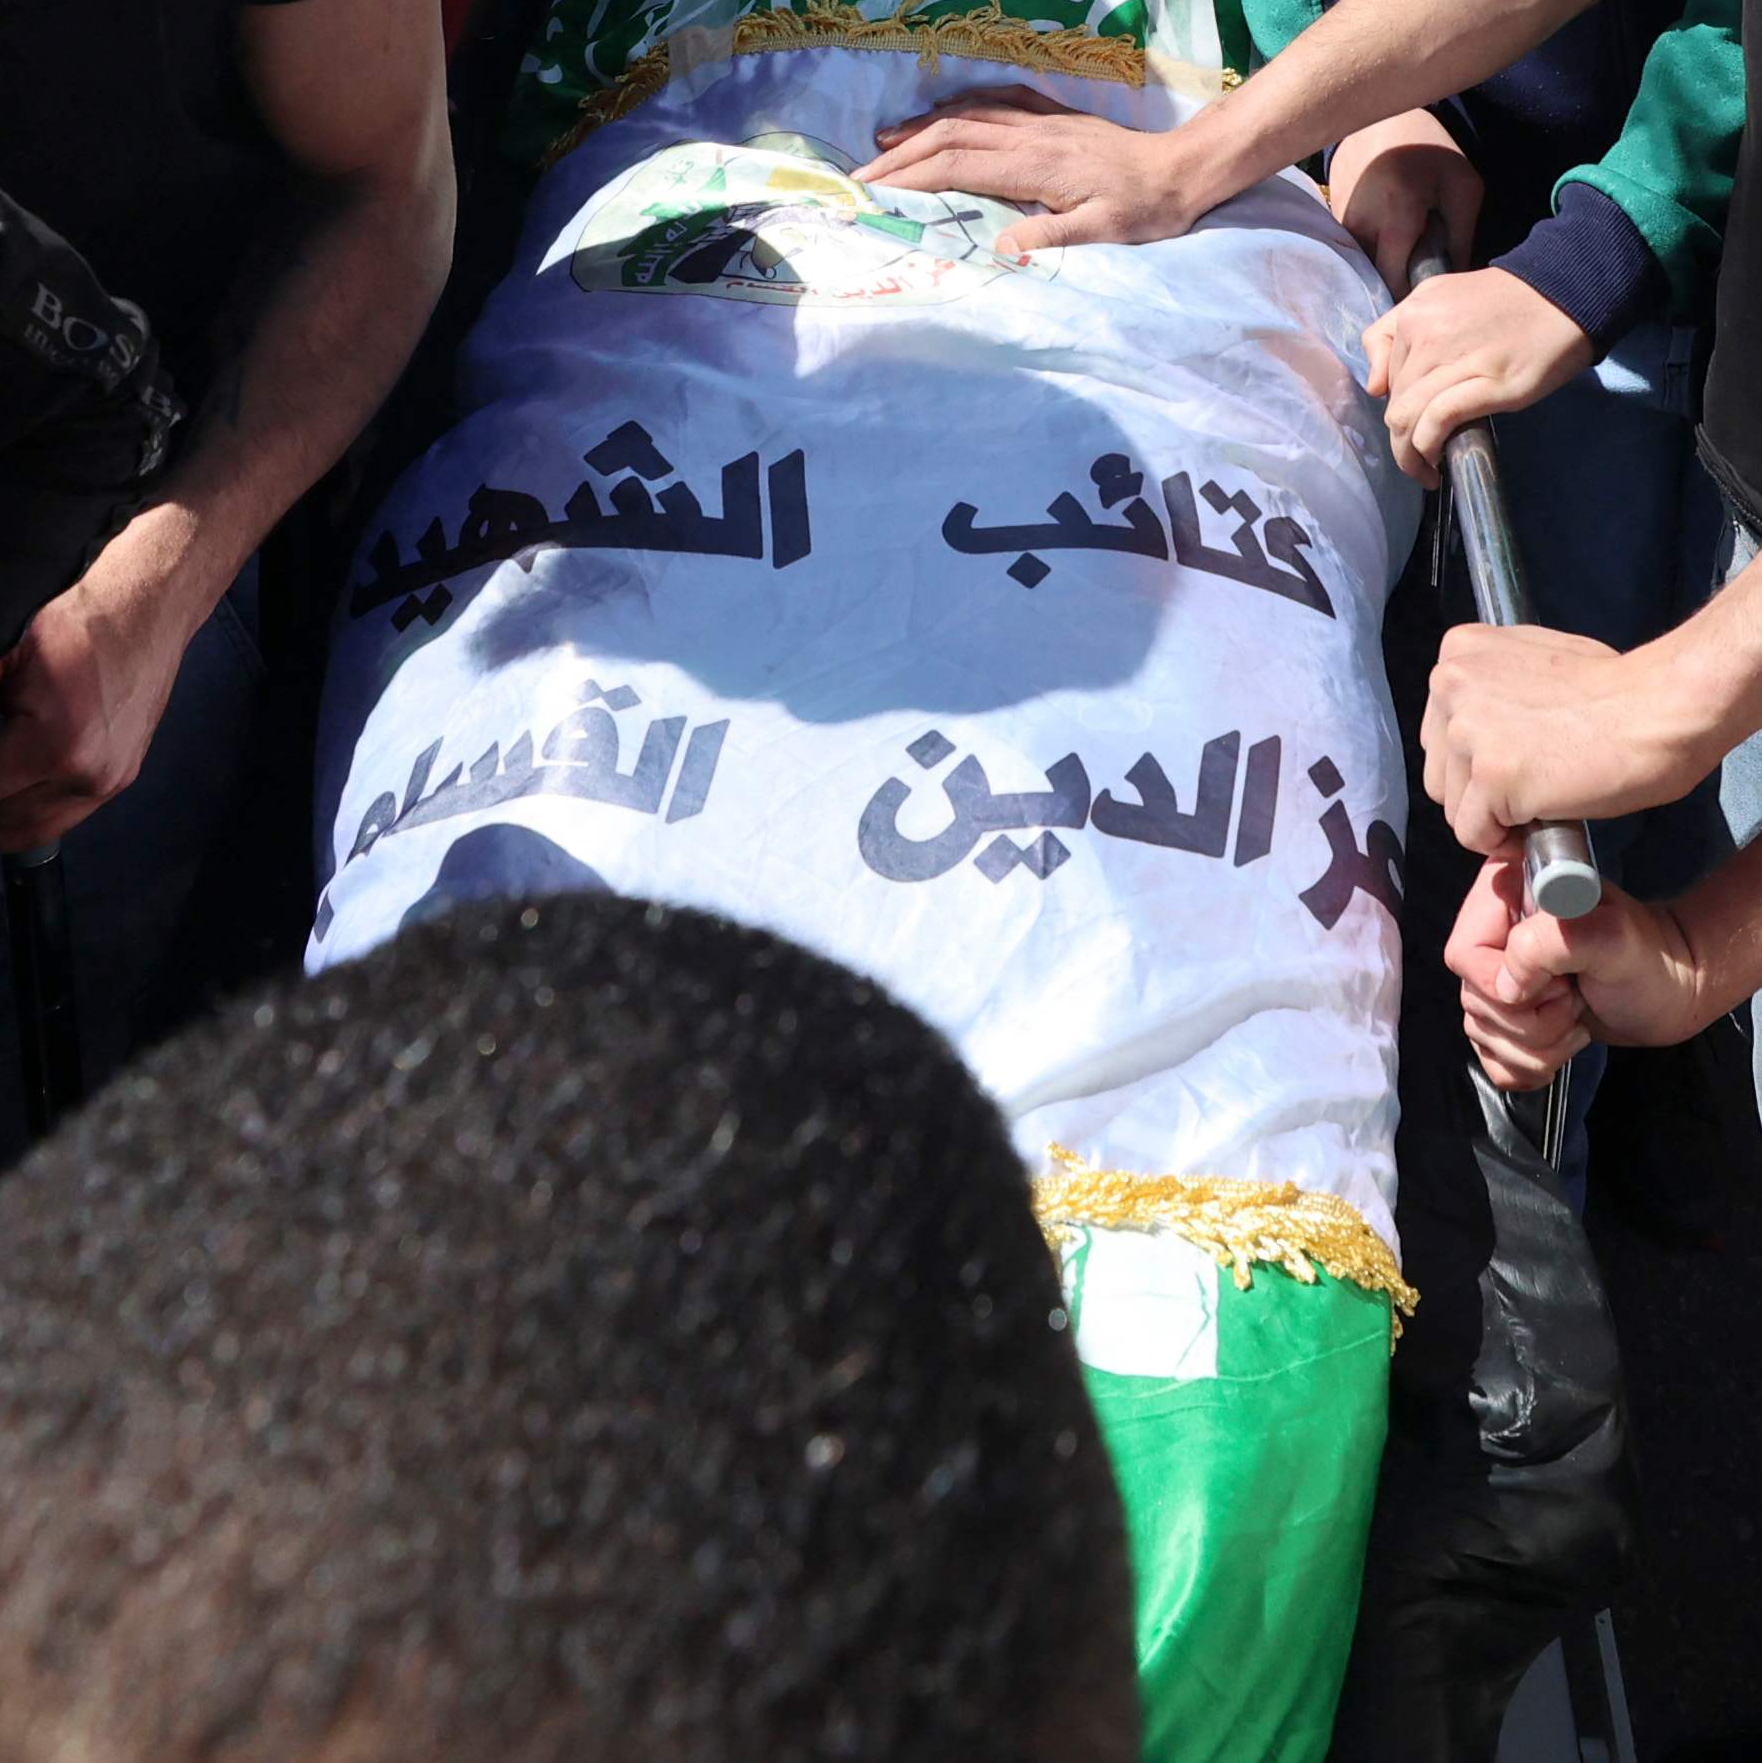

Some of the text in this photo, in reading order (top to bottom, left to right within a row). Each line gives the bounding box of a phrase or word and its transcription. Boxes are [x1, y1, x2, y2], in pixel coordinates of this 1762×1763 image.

[29, 281, 140, 370] BOS
[349, 420, 1337, 632] كتائب الشهيد
[314, 678, 1404, 944] عز الدين القسام
